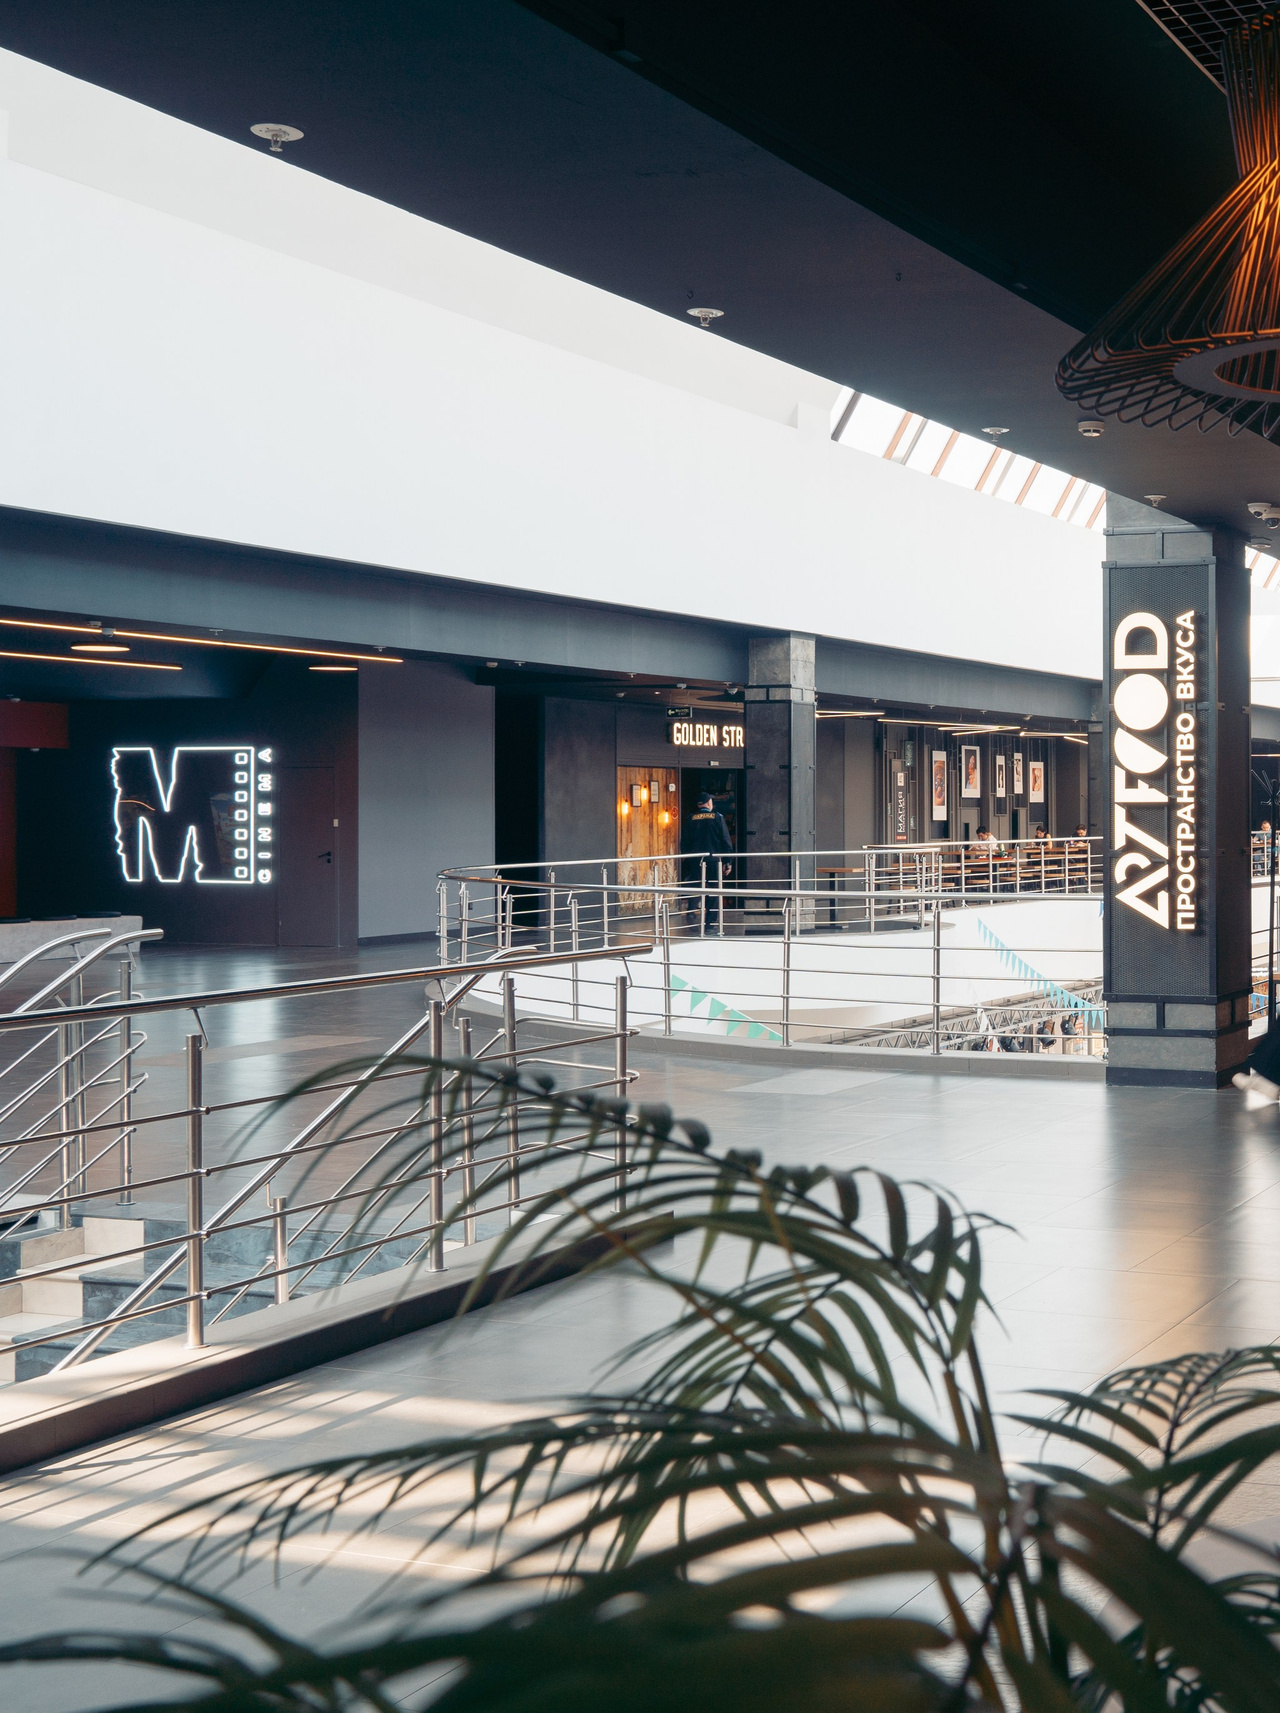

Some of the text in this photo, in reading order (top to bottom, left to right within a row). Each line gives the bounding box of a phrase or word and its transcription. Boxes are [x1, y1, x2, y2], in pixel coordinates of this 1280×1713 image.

[673, 722, 744, 747] GOLDEN STR
[1176, 610, 1195, 930] ПРОСТРАНСТВО ВКУСА
[257, 747, 272, 884] CINEMA
